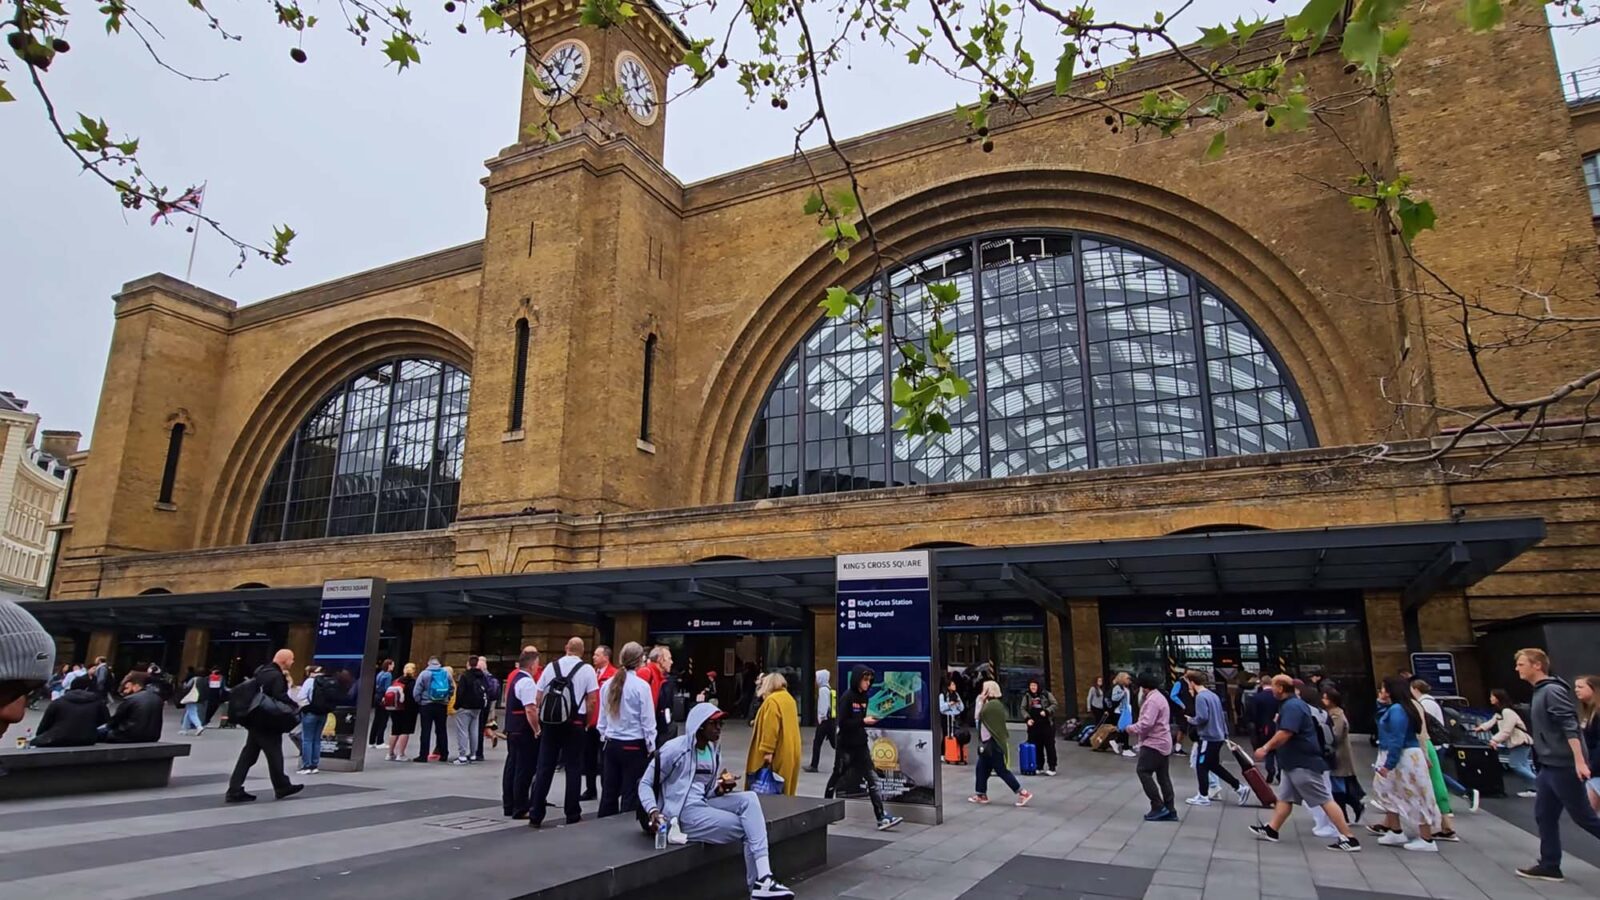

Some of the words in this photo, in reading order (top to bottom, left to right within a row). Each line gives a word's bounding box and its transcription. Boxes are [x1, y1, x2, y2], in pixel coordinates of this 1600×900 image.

[843, 562, 866, 570] KING'S
[867, 560, 891, 569] CROSS
[892, 560, 922, 568] SQUARE
[857, 599, 874, 607] King's
[857, 610, 894, 618] Underground
[1257, 608, 1274, 616] only
[743, 619, 753, 627] only
[1221, 634, 1229, 645] 1
